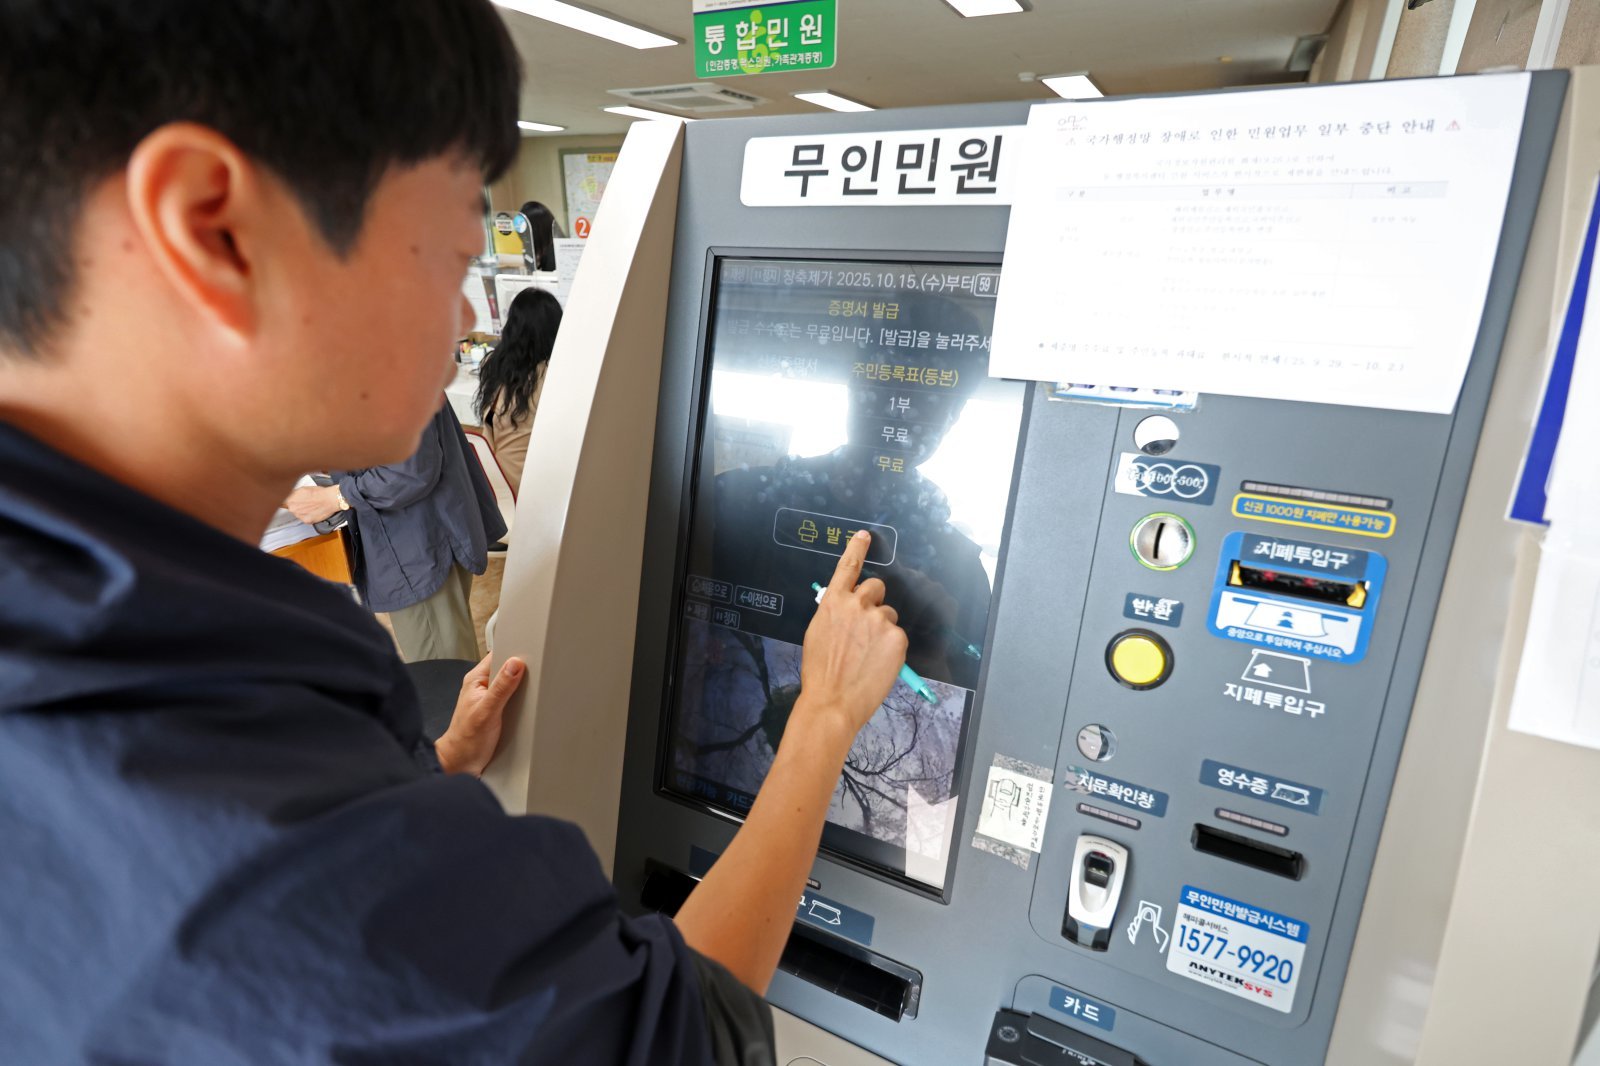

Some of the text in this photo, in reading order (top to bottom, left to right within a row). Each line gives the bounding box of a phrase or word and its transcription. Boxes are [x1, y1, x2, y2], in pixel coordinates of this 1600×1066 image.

[1401, 118, 1436, 133] 안내
[784, 135, 1002, 197] 무인민원
[577, 218, 588, 237] 2
[828, 300, 900, 320] 증명서 발급
[806, 324, 874, 344] 무료입니다.
[879, 327, 931, 349] [발급]을
[852, 361, 959, 388] 주민등록표(등본)
[889, 396, 911, 414] 1부
[881, 426, 909, 444] 무료
[877, 456, 905, 474] 무료
[1339, 513, 1386, 531] 사용가능
[1255, 541, 1350, 571] 지폐투입구
[1132, 597, 1174, 621] 반환
[1265, 634, 1302, 651] 투입하여
[1303, 640, 1343, 658] 주십시오
[1223, 683, 1326, 719] 지폐투입구
[1078, 772, 1155, 809] 지문확인창
[1217, 768, 1269, 796] 영수증
[1186, 890, 1300, 938] 무인민원발급시스템
[1179, 924, 1294, 984] 1577-9920
[1063, 995, 1100, 1022] 카드
